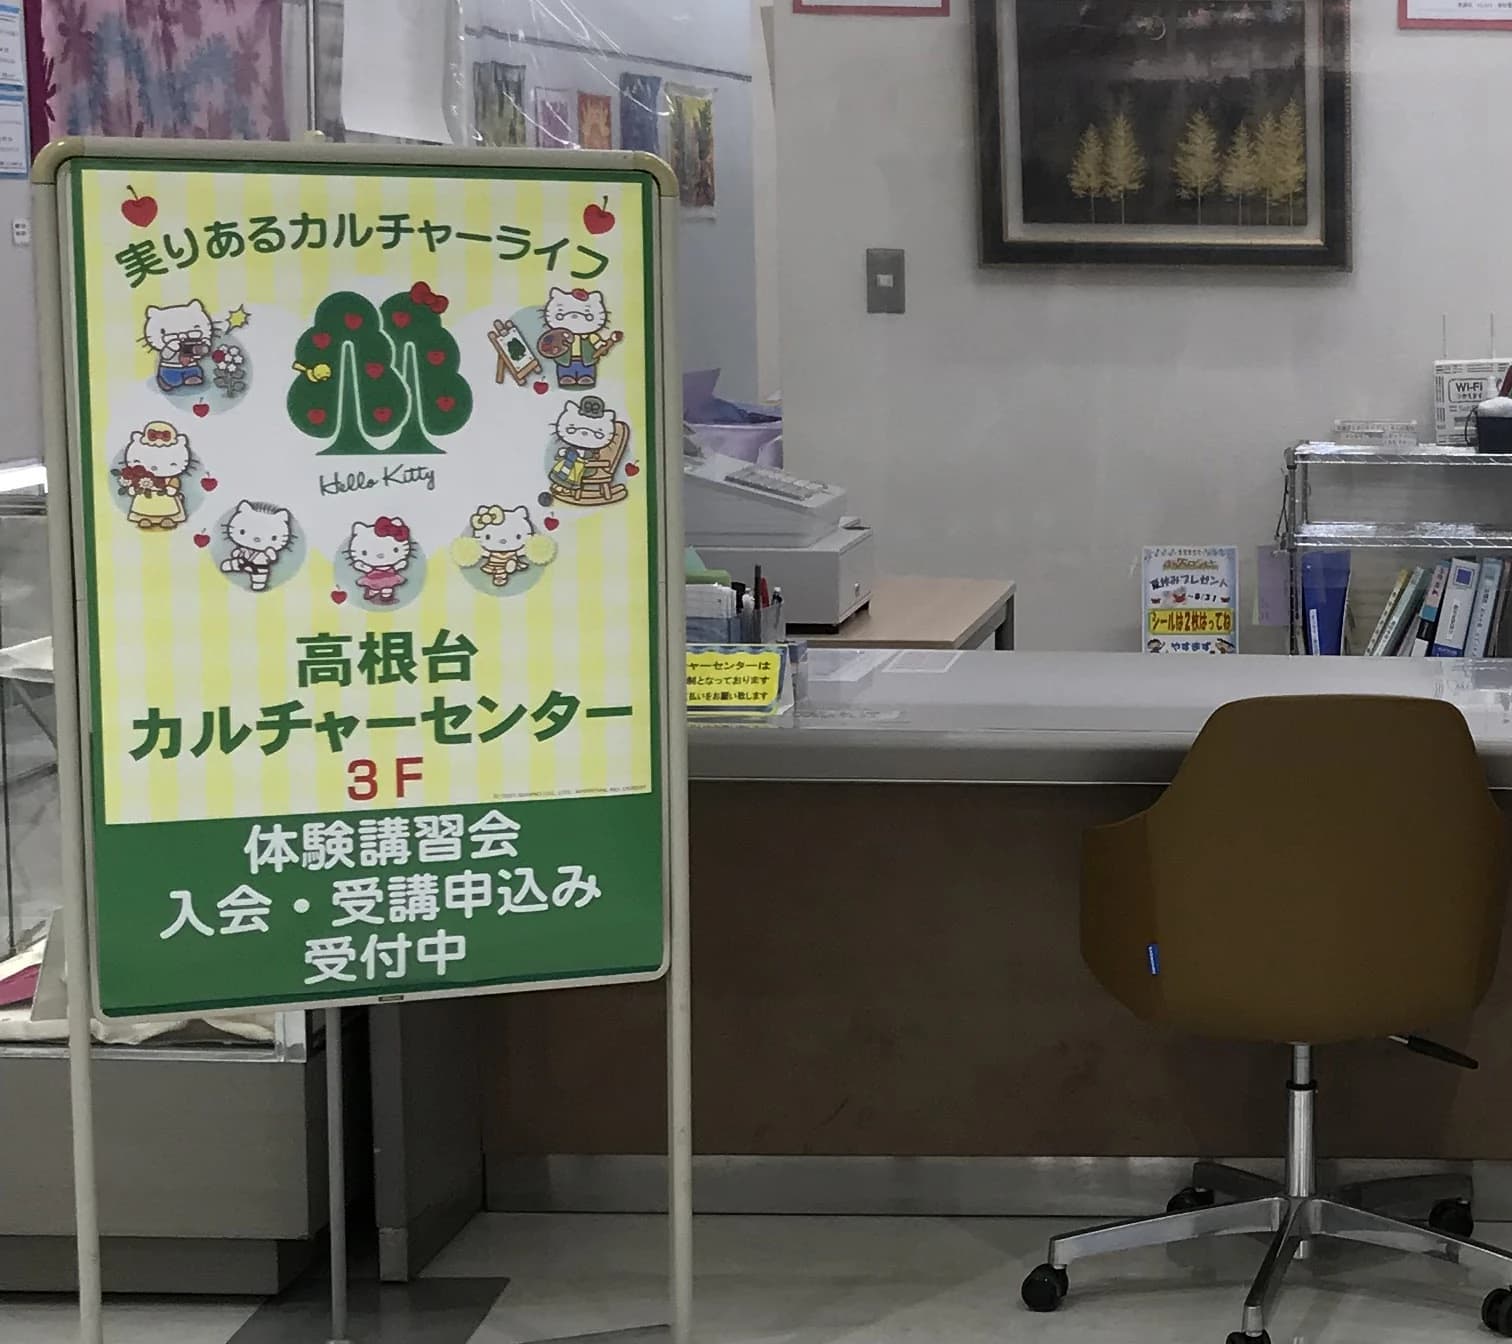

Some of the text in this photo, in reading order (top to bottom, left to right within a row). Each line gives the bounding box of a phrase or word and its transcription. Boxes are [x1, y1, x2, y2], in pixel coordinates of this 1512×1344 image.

[115, 212, 610, 288] 実りあるカルチャーライフ
[319, 465, 436, 497] Hello Kitty
[297, 629, 478, 687] 高根台
[129, 690, 633, 761] カルチャーセンター
[347, 756, 424, 801] 3F
[244, 808, 522, 874] 体験講習会
[159, 864, 602, 940] 入会・受講申込み
[304, 928, 467, 985] 受付中
